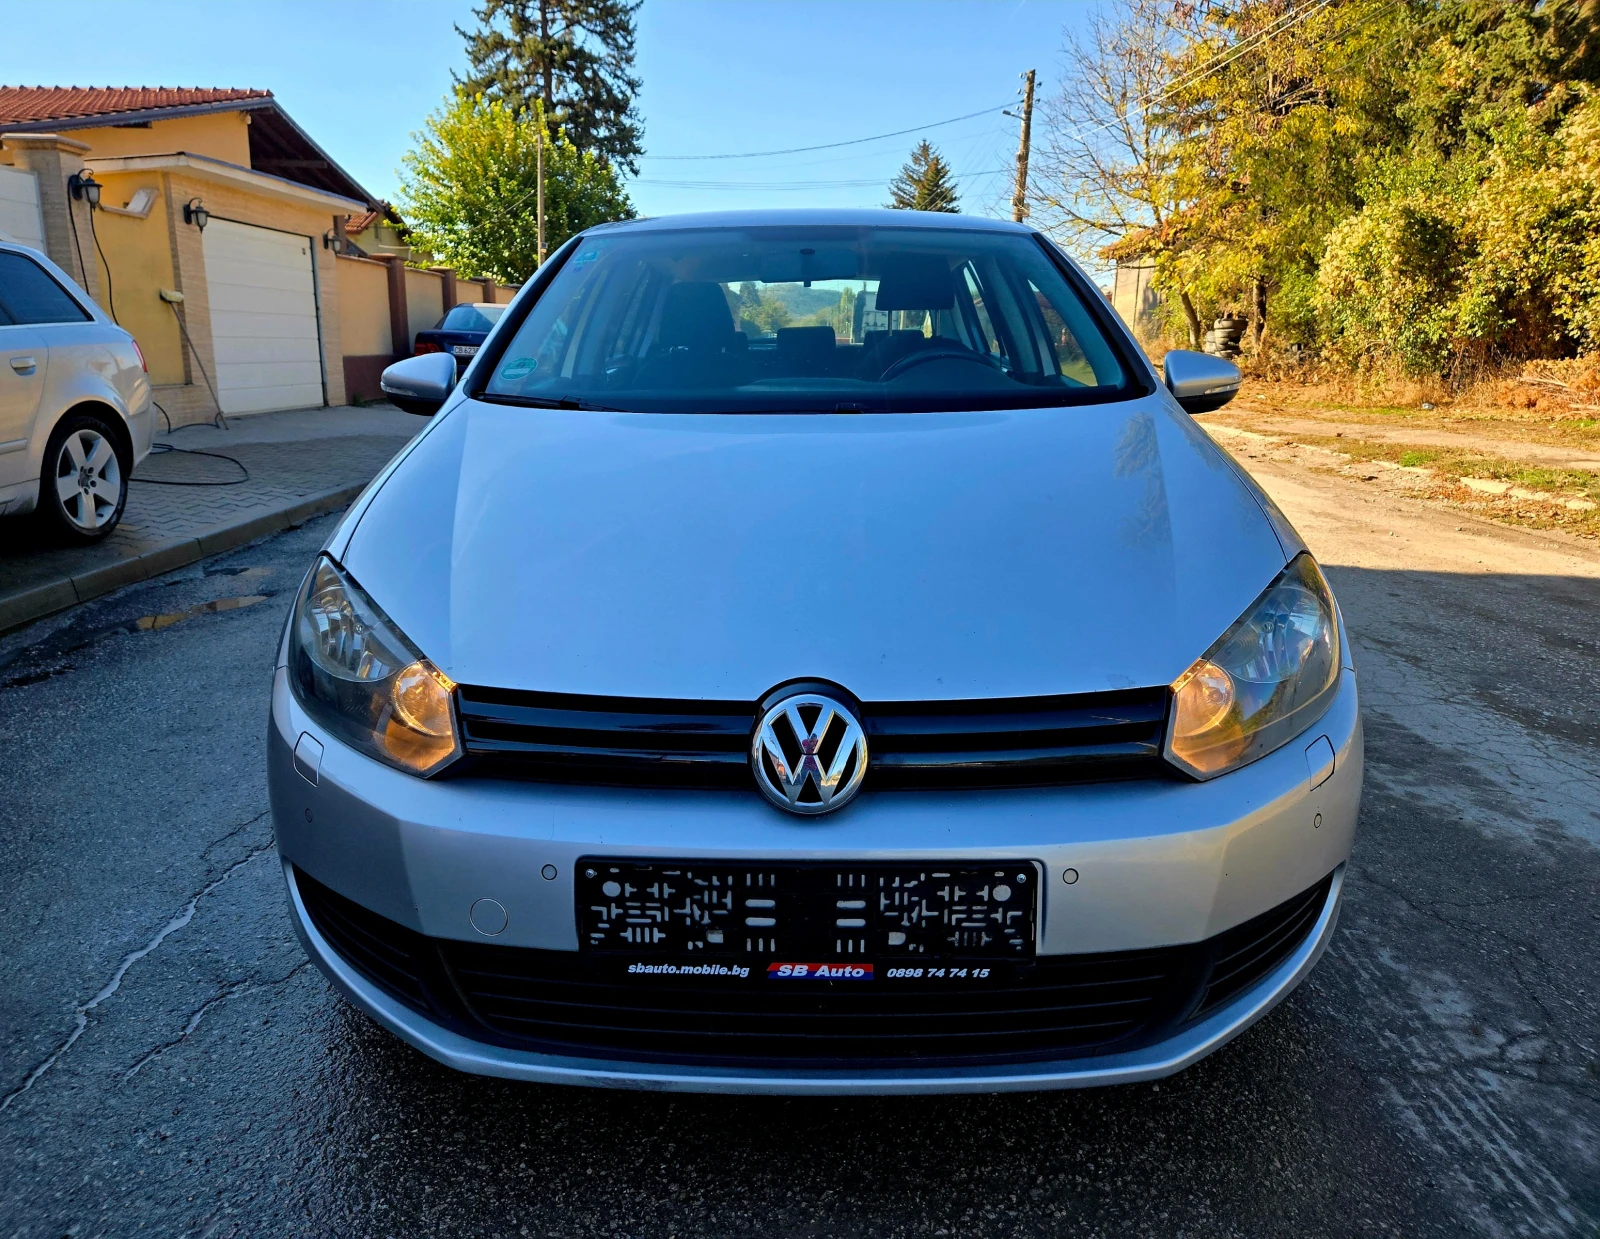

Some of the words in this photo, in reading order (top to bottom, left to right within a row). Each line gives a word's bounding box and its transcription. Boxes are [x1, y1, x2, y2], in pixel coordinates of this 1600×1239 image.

[752, 694, 868, 814] VW
[627, 962, 750, 978] sbauto.mobile.bg
[777, 964, 809, 977] SB
[814, 965, 865, 978] Auto
[886, 968, 924, 978] 0898
[927, 968, 946, 978] 74
[949, 968, 968, 978] 74
[971, 968, 991, 978] 15
